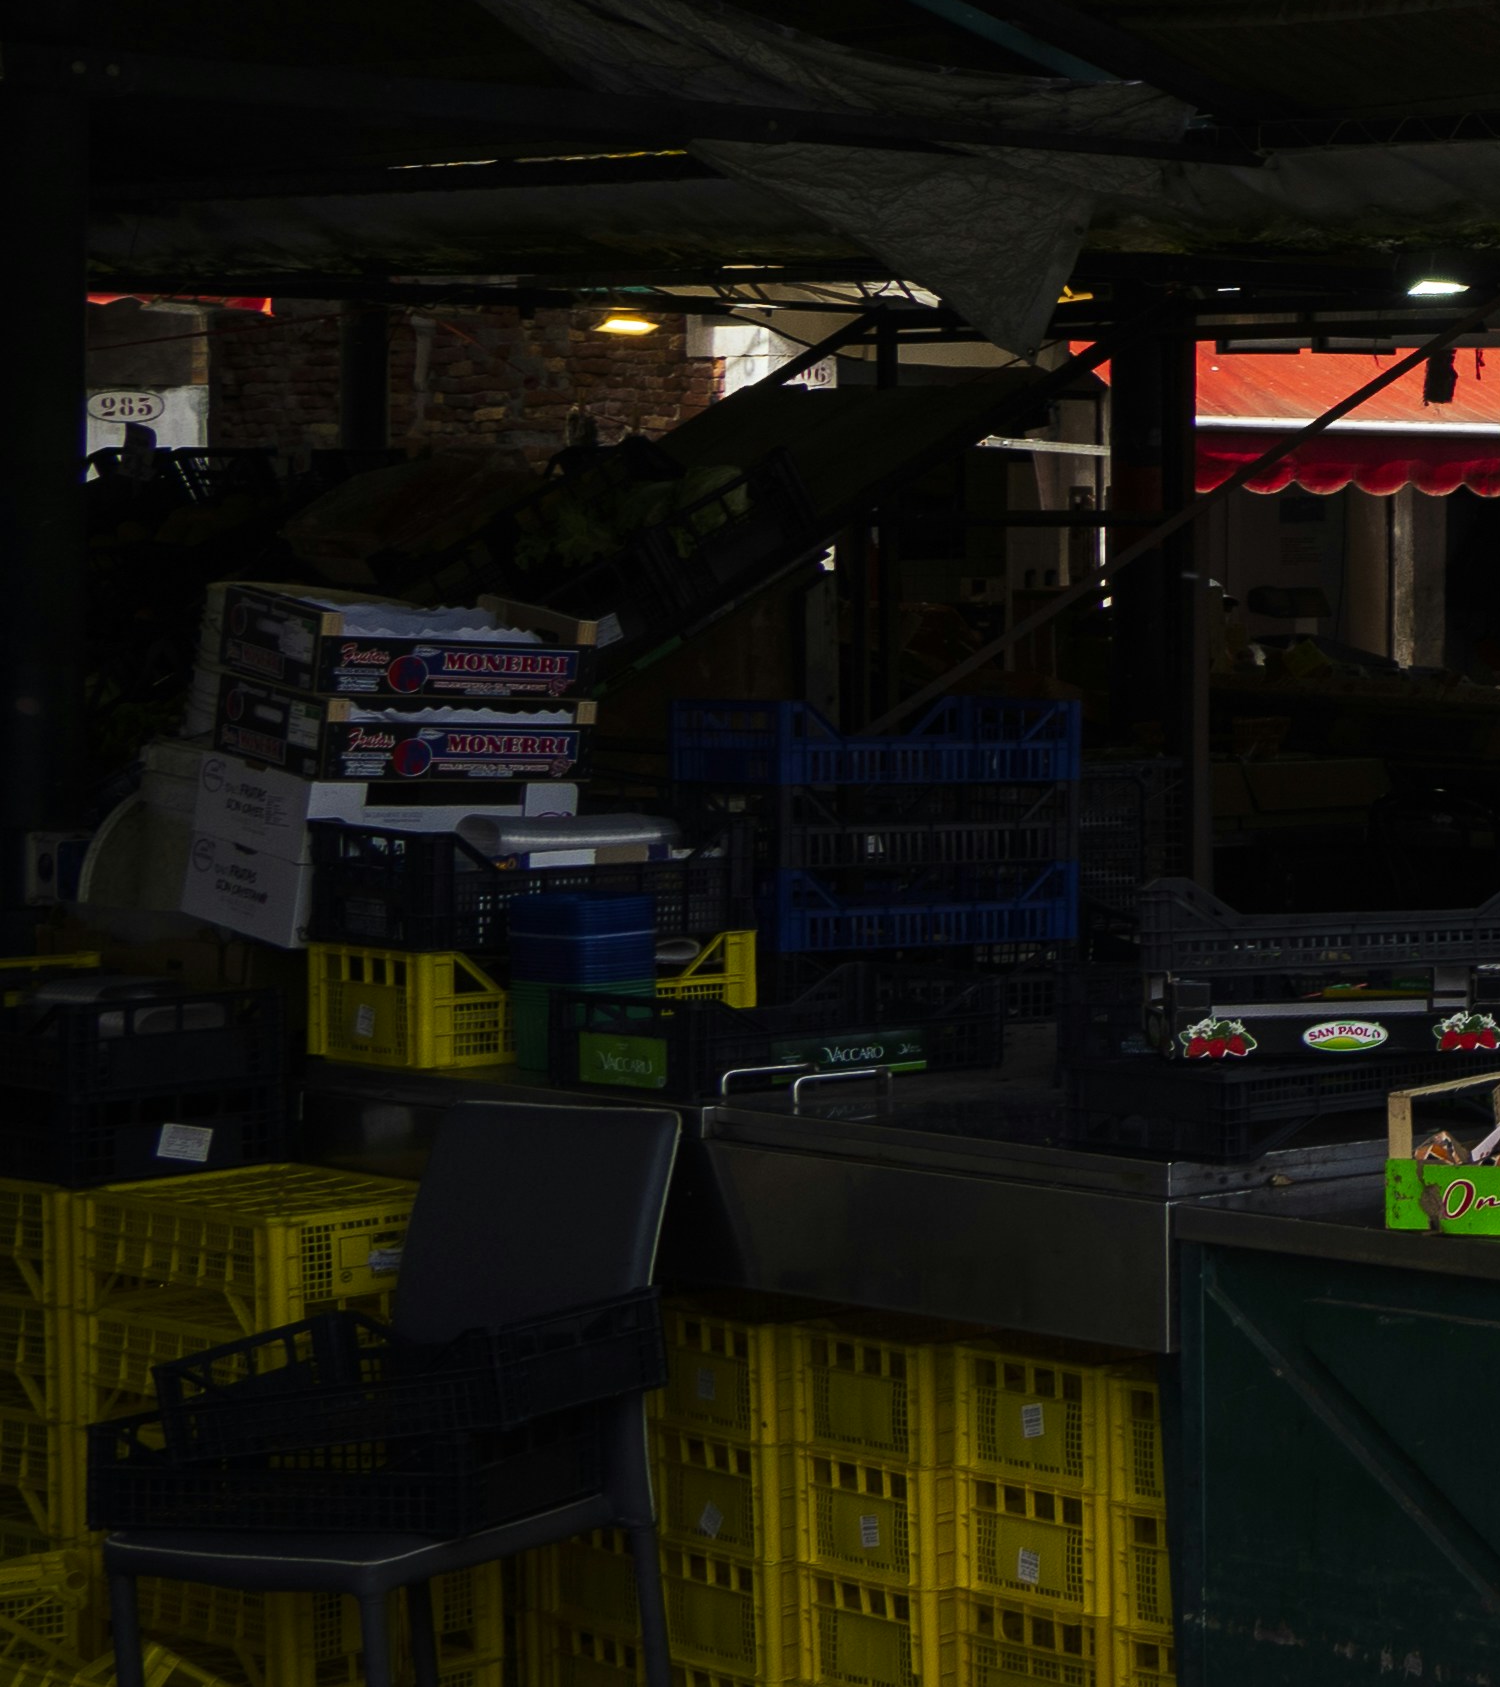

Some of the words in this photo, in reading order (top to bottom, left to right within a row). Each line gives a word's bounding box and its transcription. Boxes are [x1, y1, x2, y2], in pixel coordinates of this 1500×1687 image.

[101, 397, 153, 417] 285
[442, 651, 569, 676] MONERRI
[447, 734, 570, 755] MONERRI
[1308, 1026, 1336, 1041] SAN
